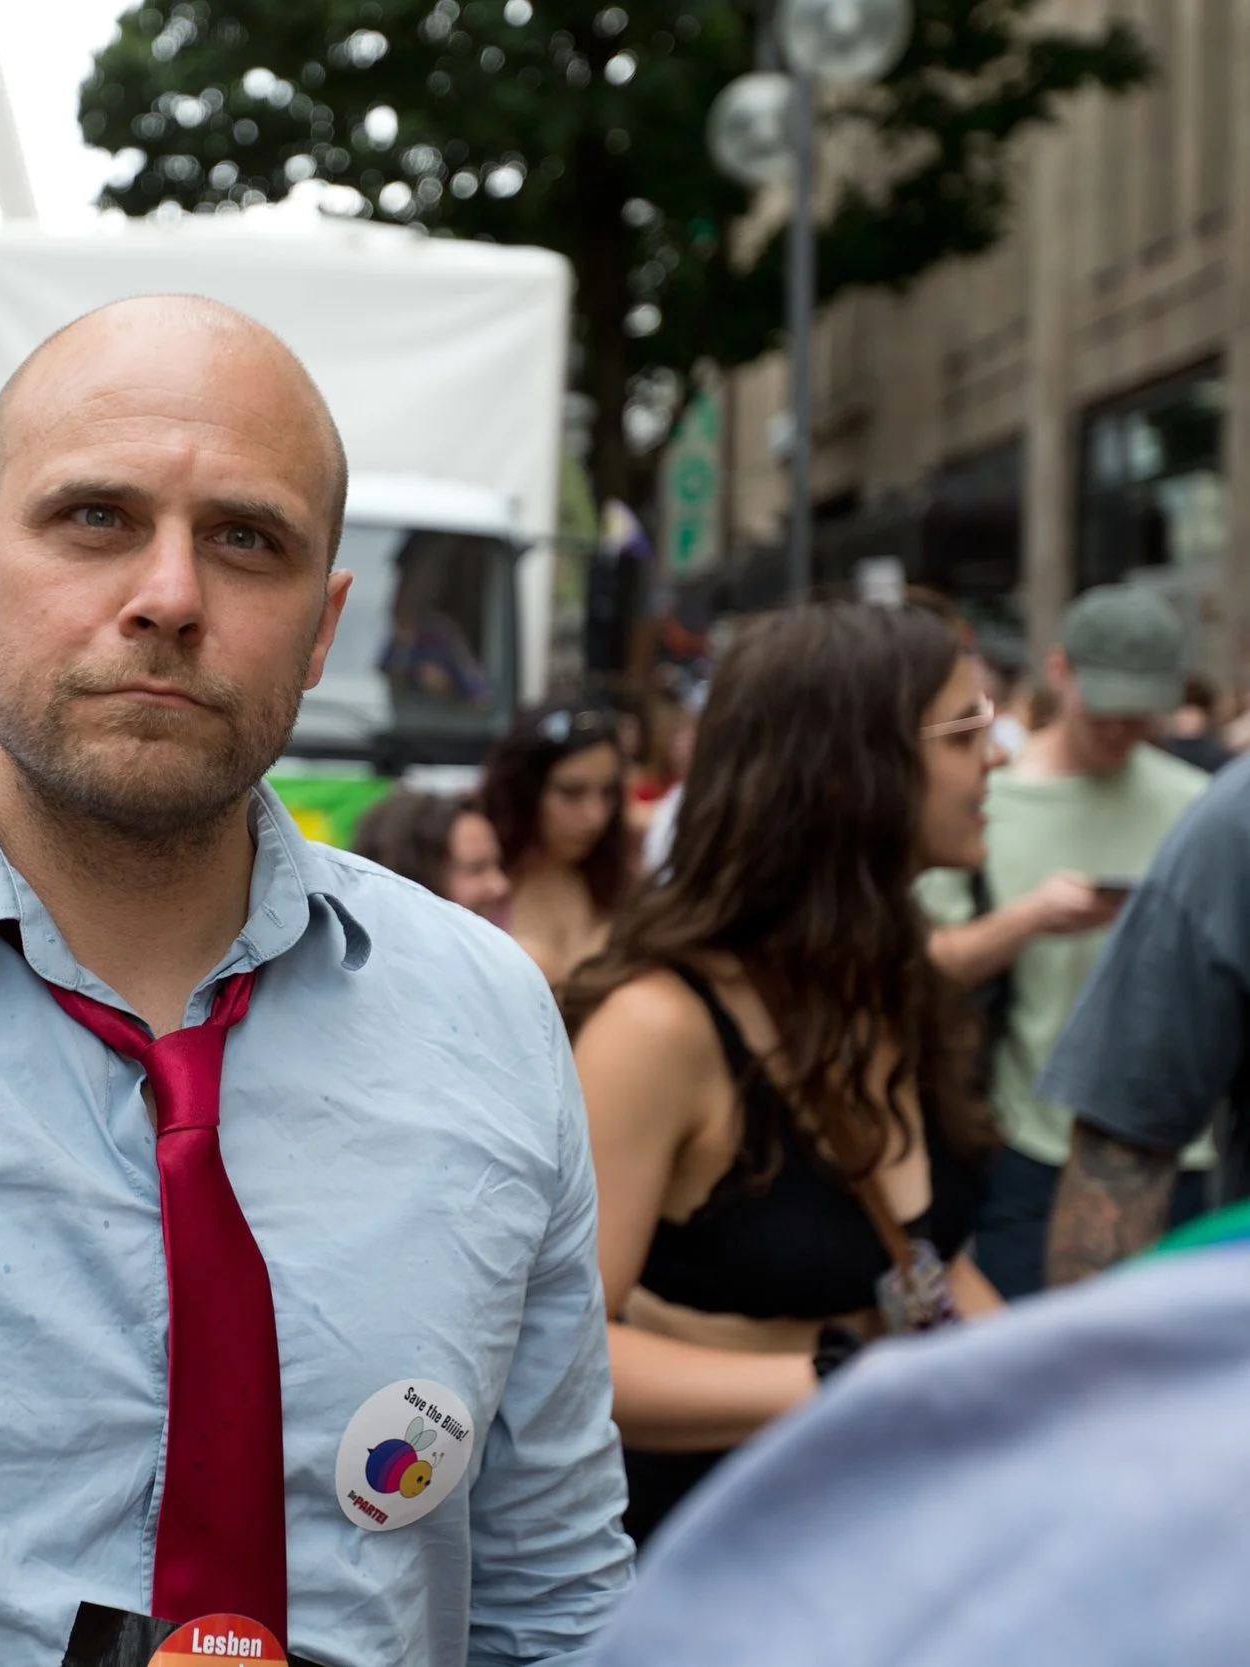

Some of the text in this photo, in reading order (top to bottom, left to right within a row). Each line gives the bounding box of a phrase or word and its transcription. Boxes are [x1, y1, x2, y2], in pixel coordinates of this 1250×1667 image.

[404, 1386, 469, 1442] Save the Biiiis!
[353, 1495, 389, 1525] PARTEI
[192, 1627, 262, 1658] Lesben
